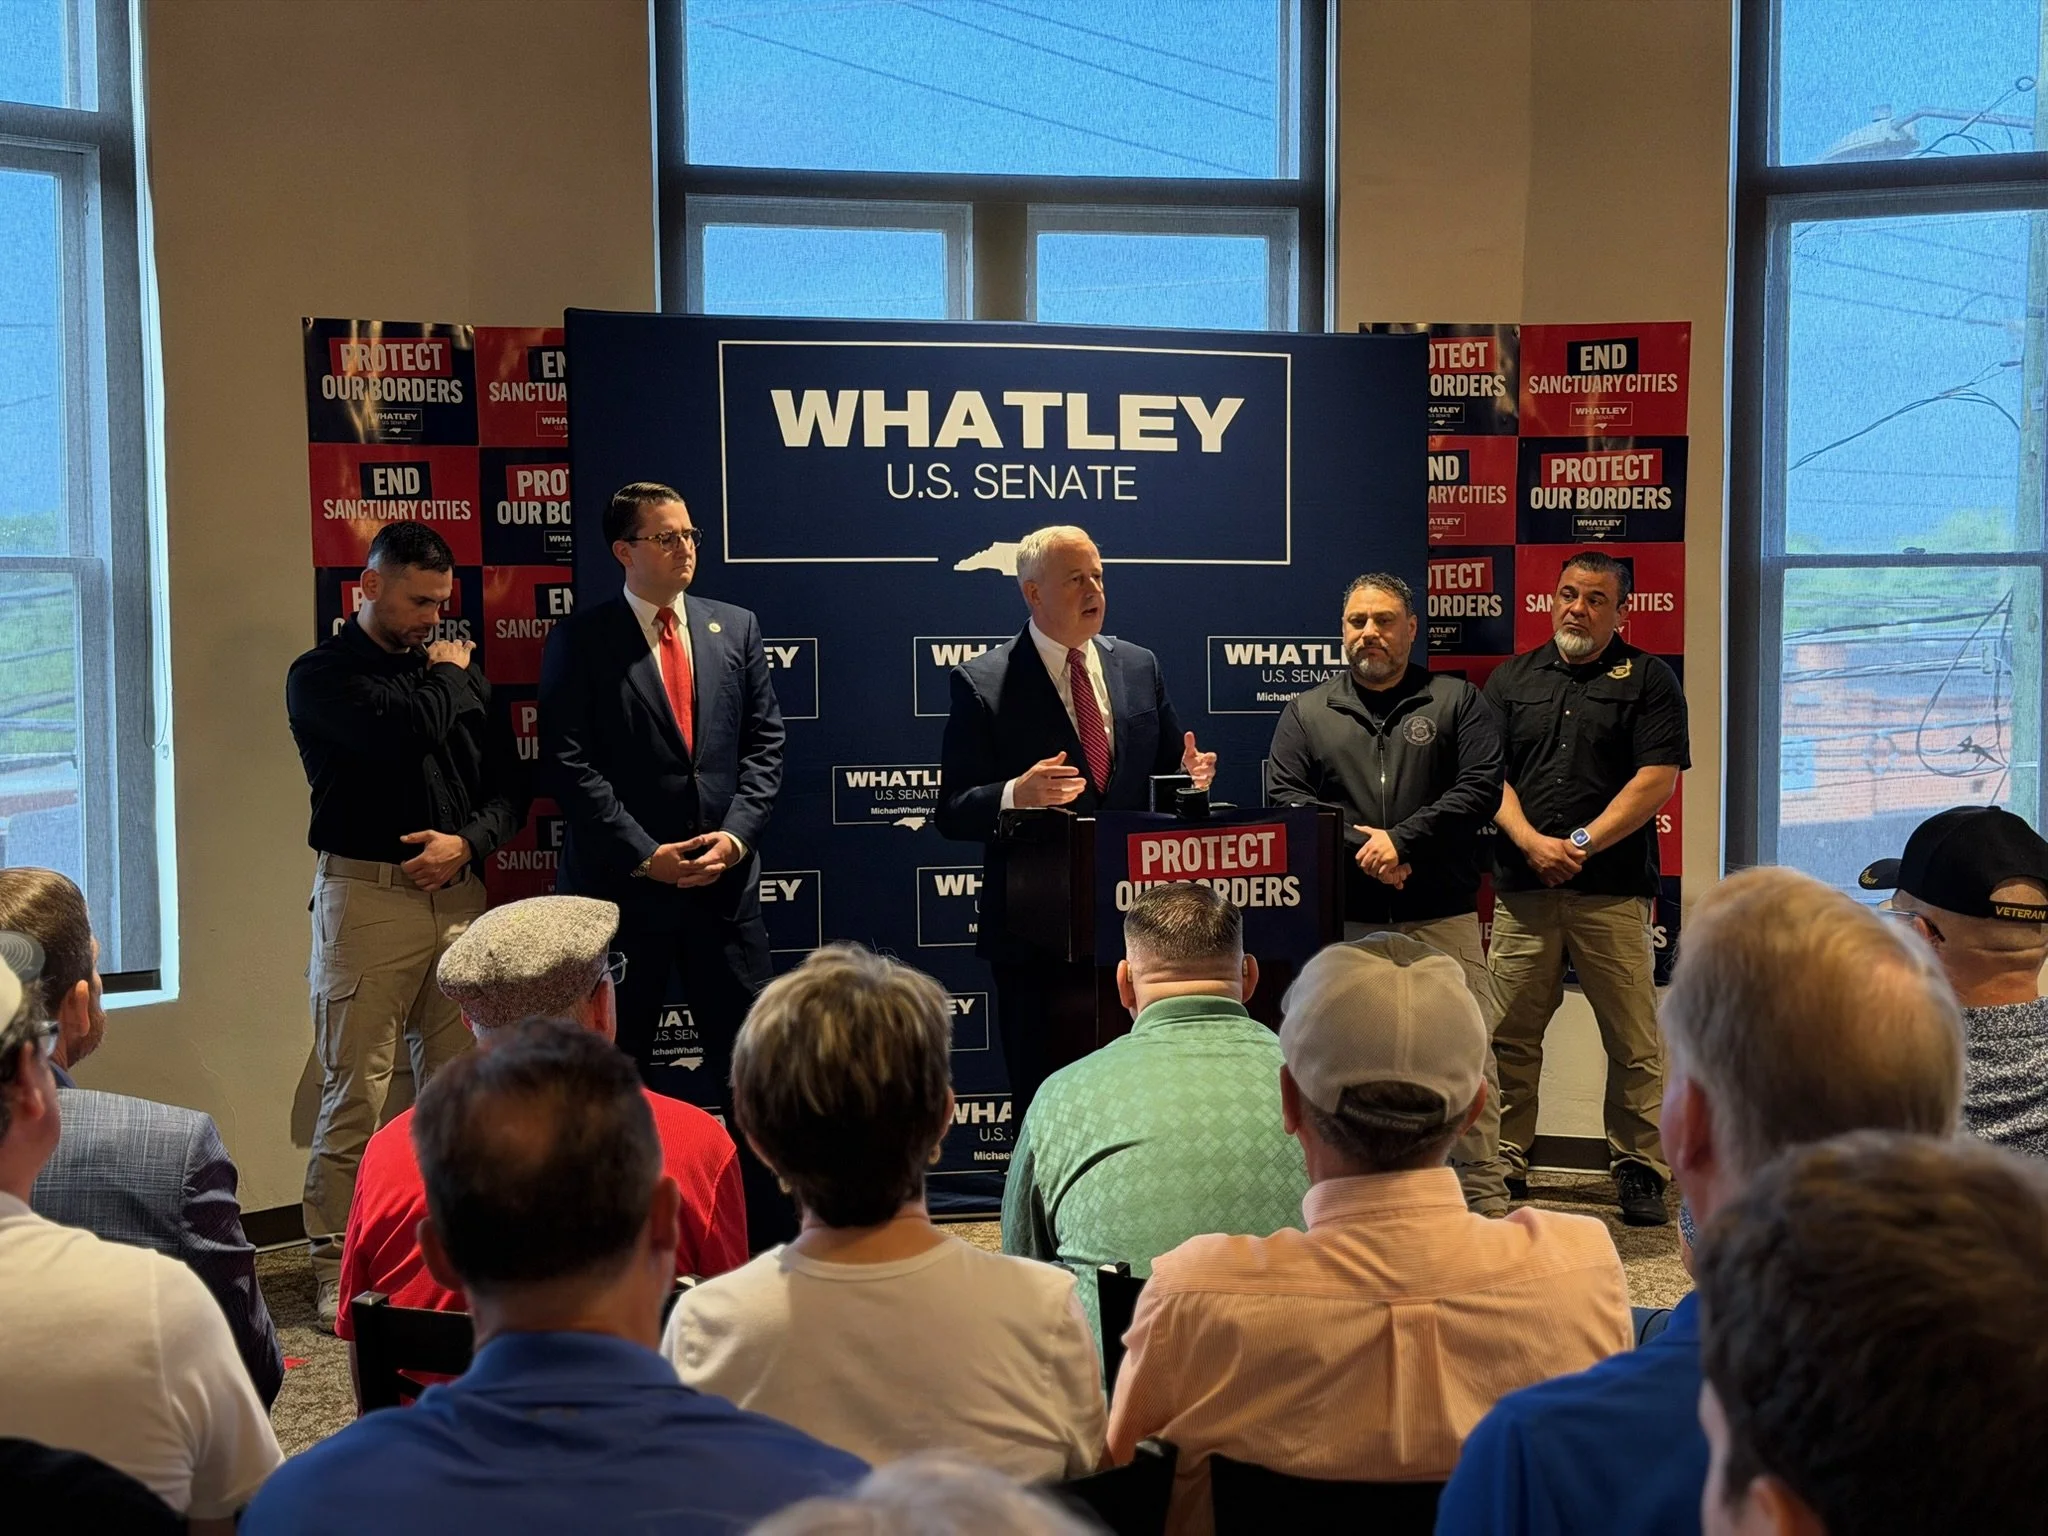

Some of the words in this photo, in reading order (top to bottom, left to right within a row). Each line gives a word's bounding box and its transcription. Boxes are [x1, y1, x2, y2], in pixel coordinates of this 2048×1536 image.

[340, 343, 443, 372] PROTECT
[542, 351, 567, 378] EN
[1580, 344, 1628, 372] END
[322, 374, 364, 401] OUR
[369, 377, 464, 404] BORDERS
[488, 381, 567, 402] SANCTUA
[1429, 375, 1507, 397] ORDERS
[1529, 374, 1624, 394] SANCTUARY
[1626, 373, 1678, 393] CITIES
[771, 389, 1244, 452] WHATLEY
[1575, 406, 1627, 415] WHATLEY
[1428, 455, 1460, 481] ND
[1551, 454, 1654, 484] PROTECT
[373, 467, 421, 496] END
[887, 463, 959, 499] U.S.
[974, 464, 1138, 500] SENATE
[1458, 485, 1507, 504] CITIES
[1530, 487, 1572, 510] OUR
[1576, 487, 1672, 510] BORDERS
[323, 499, 418, 520] SANCTUARY
[421, 500, 472, 521] CITIES
[497, 501, 542, 525] OUR
[1429, 517, 1461, 525] ATLEY
[1577, 519, 1622, 527] WHATLEY
[548, 587, 574, 615] EN
[1428, 594, 1503, 618] ORDERS
[1429, 626, 1457, 634] ATLEY
[1262, 669, 1288, 683] U.S.
[875, 790, 895, 801] U.S.
[870, 806, 936, 816] MichaelWhatley.c
[1141, 832, 1275, 875] PROTECT
[1995, 905, 2047, 920] VETERAN
[674, 1029, 699, 1041] SEN
[979, 1127, 1008, 1142] U.S.
